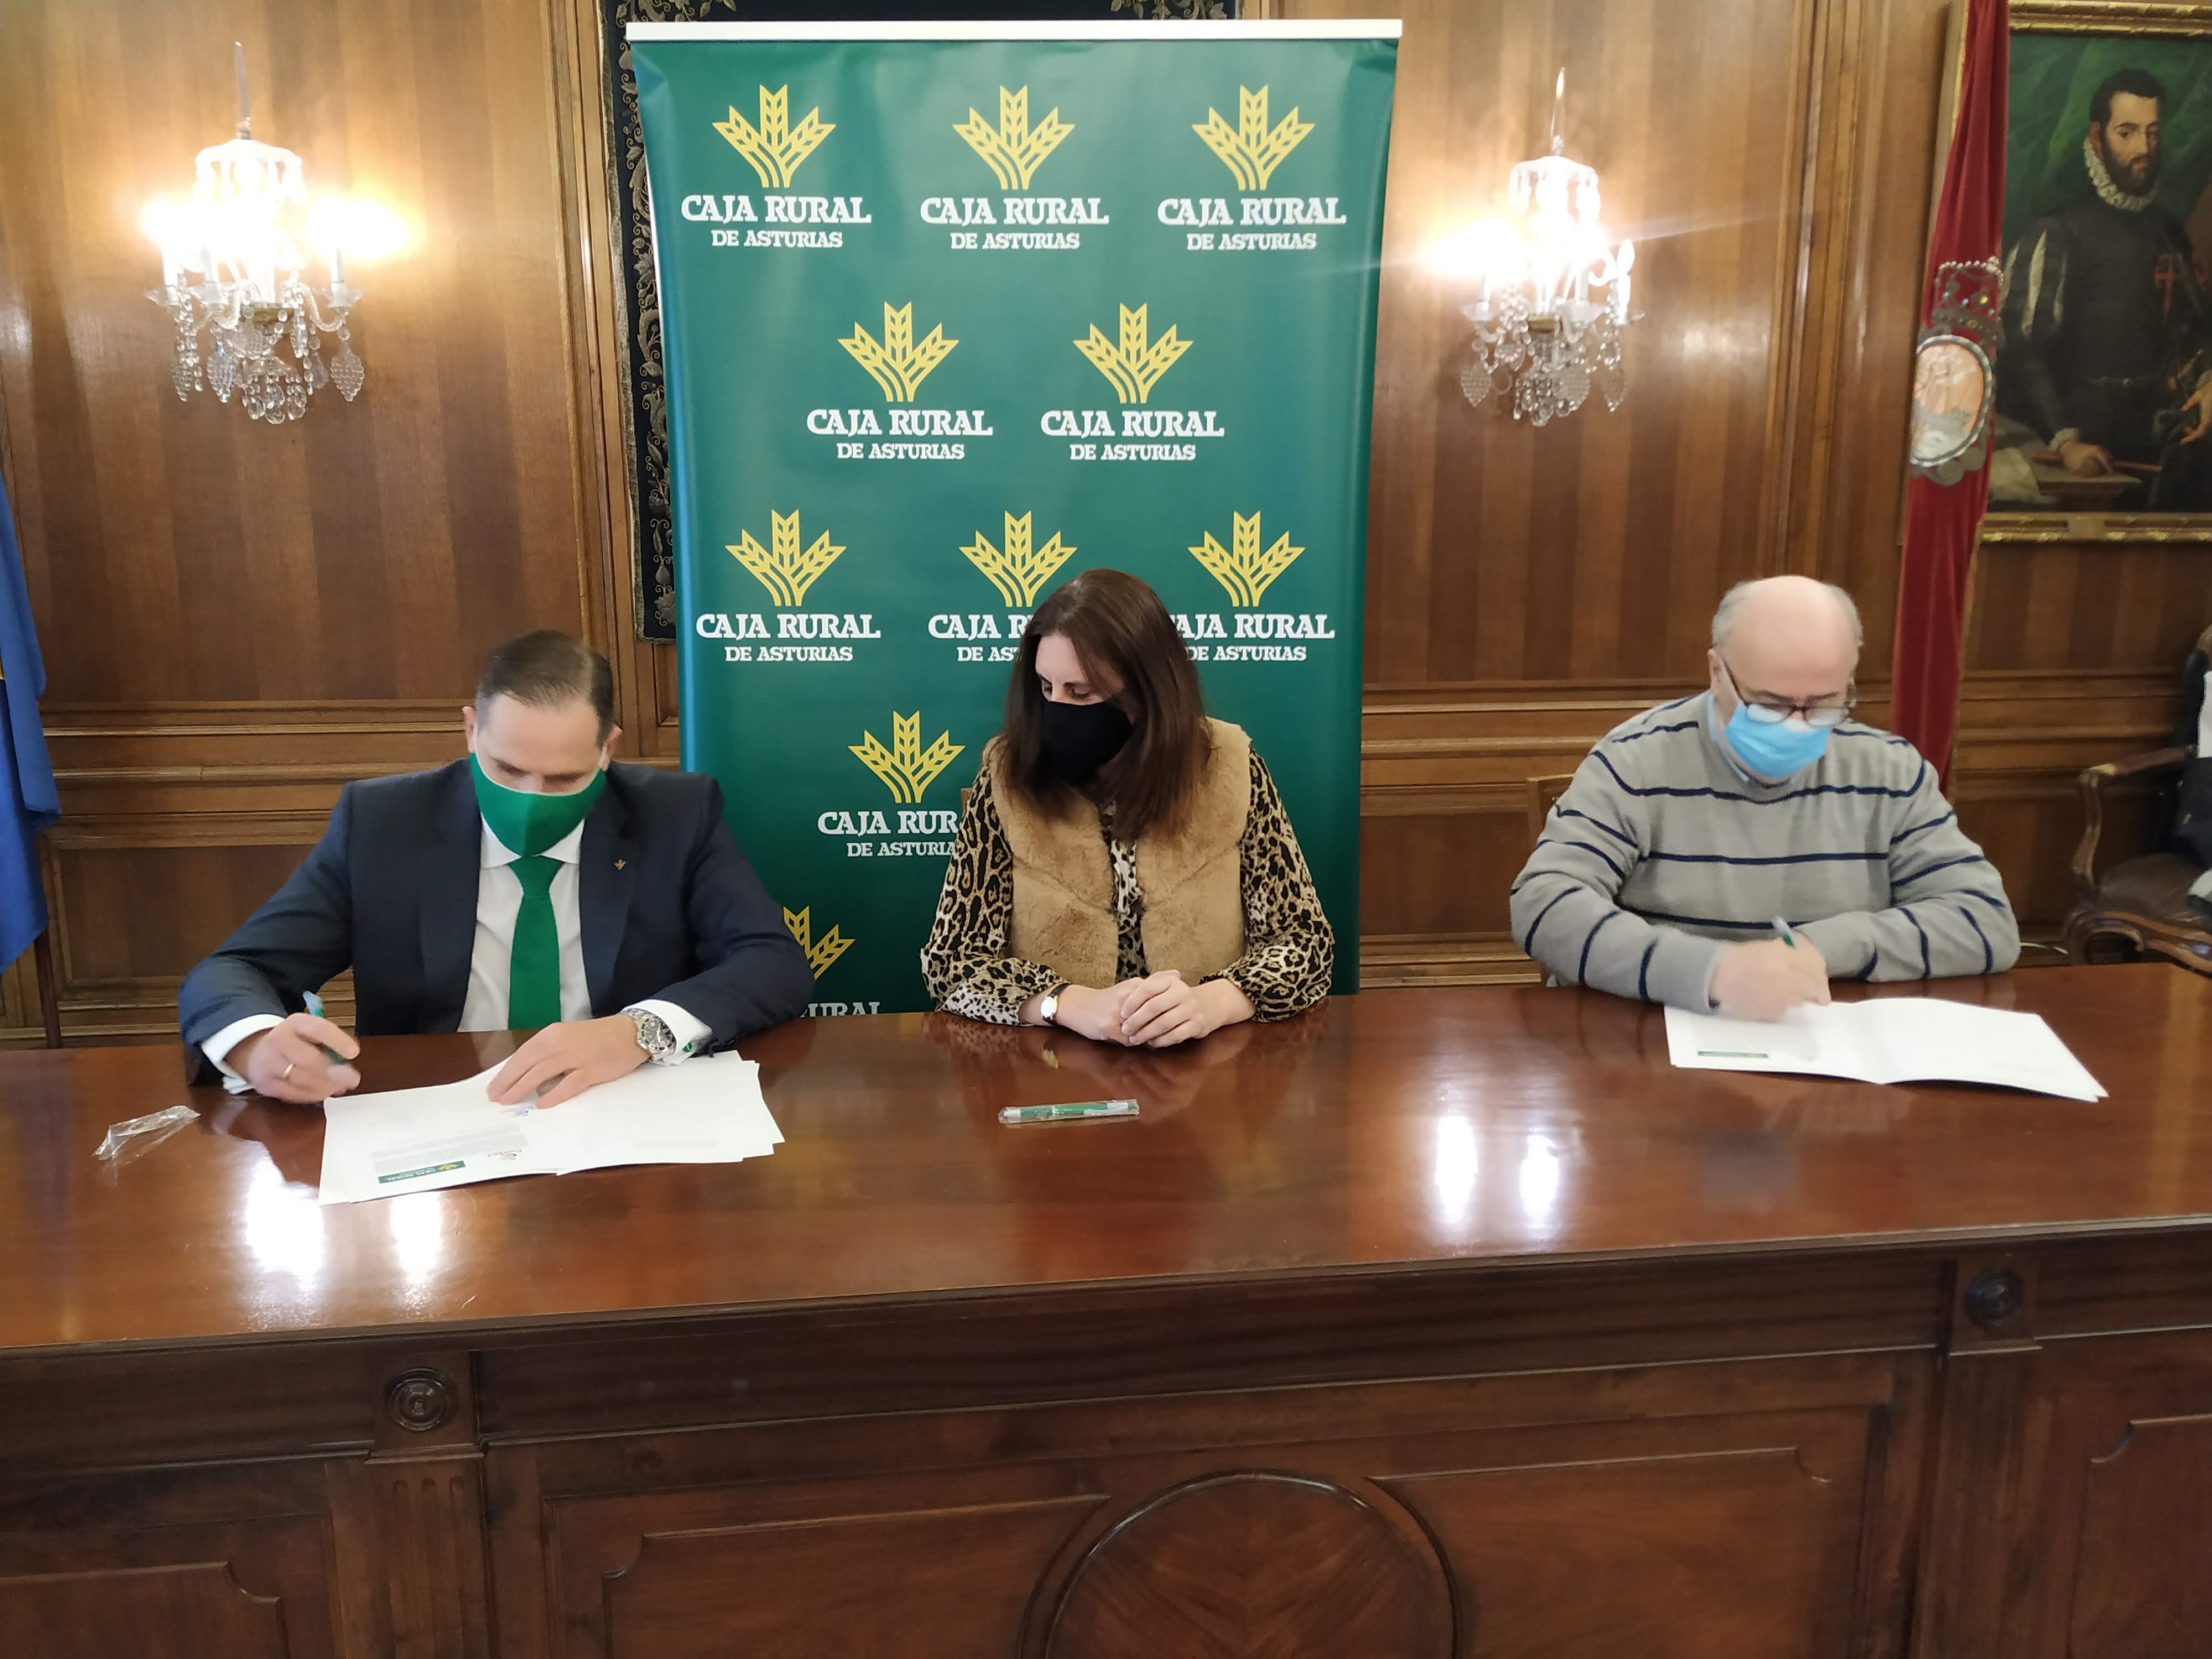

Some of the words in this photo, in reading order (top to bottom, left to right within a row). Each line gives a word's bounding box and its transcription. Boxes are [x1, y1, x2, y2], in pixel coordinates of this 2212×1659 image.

[681, 195, 758, 225] CAJA
[764, 195, 872, 225] RURAL
[920, 196, 998, 227] CAJA
[1003, 197, 1110, 226] RURAL
[1157, 197, 1234, 228] CAJA
[1240, 197, 1347, 227] RURAL
[711, 229, 739, 247] DE
[743, 229, 843, 248] ASTURIAS
[950, 232, 978, 250] DE
[982, 232, 1081, 250] ASTURIAS
[1186, 233, 1214, 251] DE
[1218, 232, 1318, 251] ASTURIAS
[806, 409, 883, 438] CAJA
[888, 409, 994, 437] RURAL
[1040, 410, 1115, 439] CAJA
[1121, 410, 1225, 438] RURAL
[836, 442, 864, 460] DE
[868, 442, 965, 460] ASTURIAS
[1070, 444, 1097, 461] DE
[1100, 444, 1197, 461] ASTURIAS
[696, 613, 771, 641] CAJA
[776, 613, 881, 639] RURAL
[928, 614, 1001, 641] CAJA
[1168, 614, 1228, 640] AJA
[1234, 614, 1335, 639] RURAL
[724, 646, 752, 662] DE
[756, 646, 853, 662] ASTURIAS
[957, 646, 983, 661] DE
[1186, 646, 1209, 661] DE
[1213, 646, 1307, 661] ASTURIAS
[817, 811, 891, 837] CAJA
[897, 810, 959, 834] RUR
[846, 842, 873, 857] DE
[877, 841, 955, 857] ASTURIA
